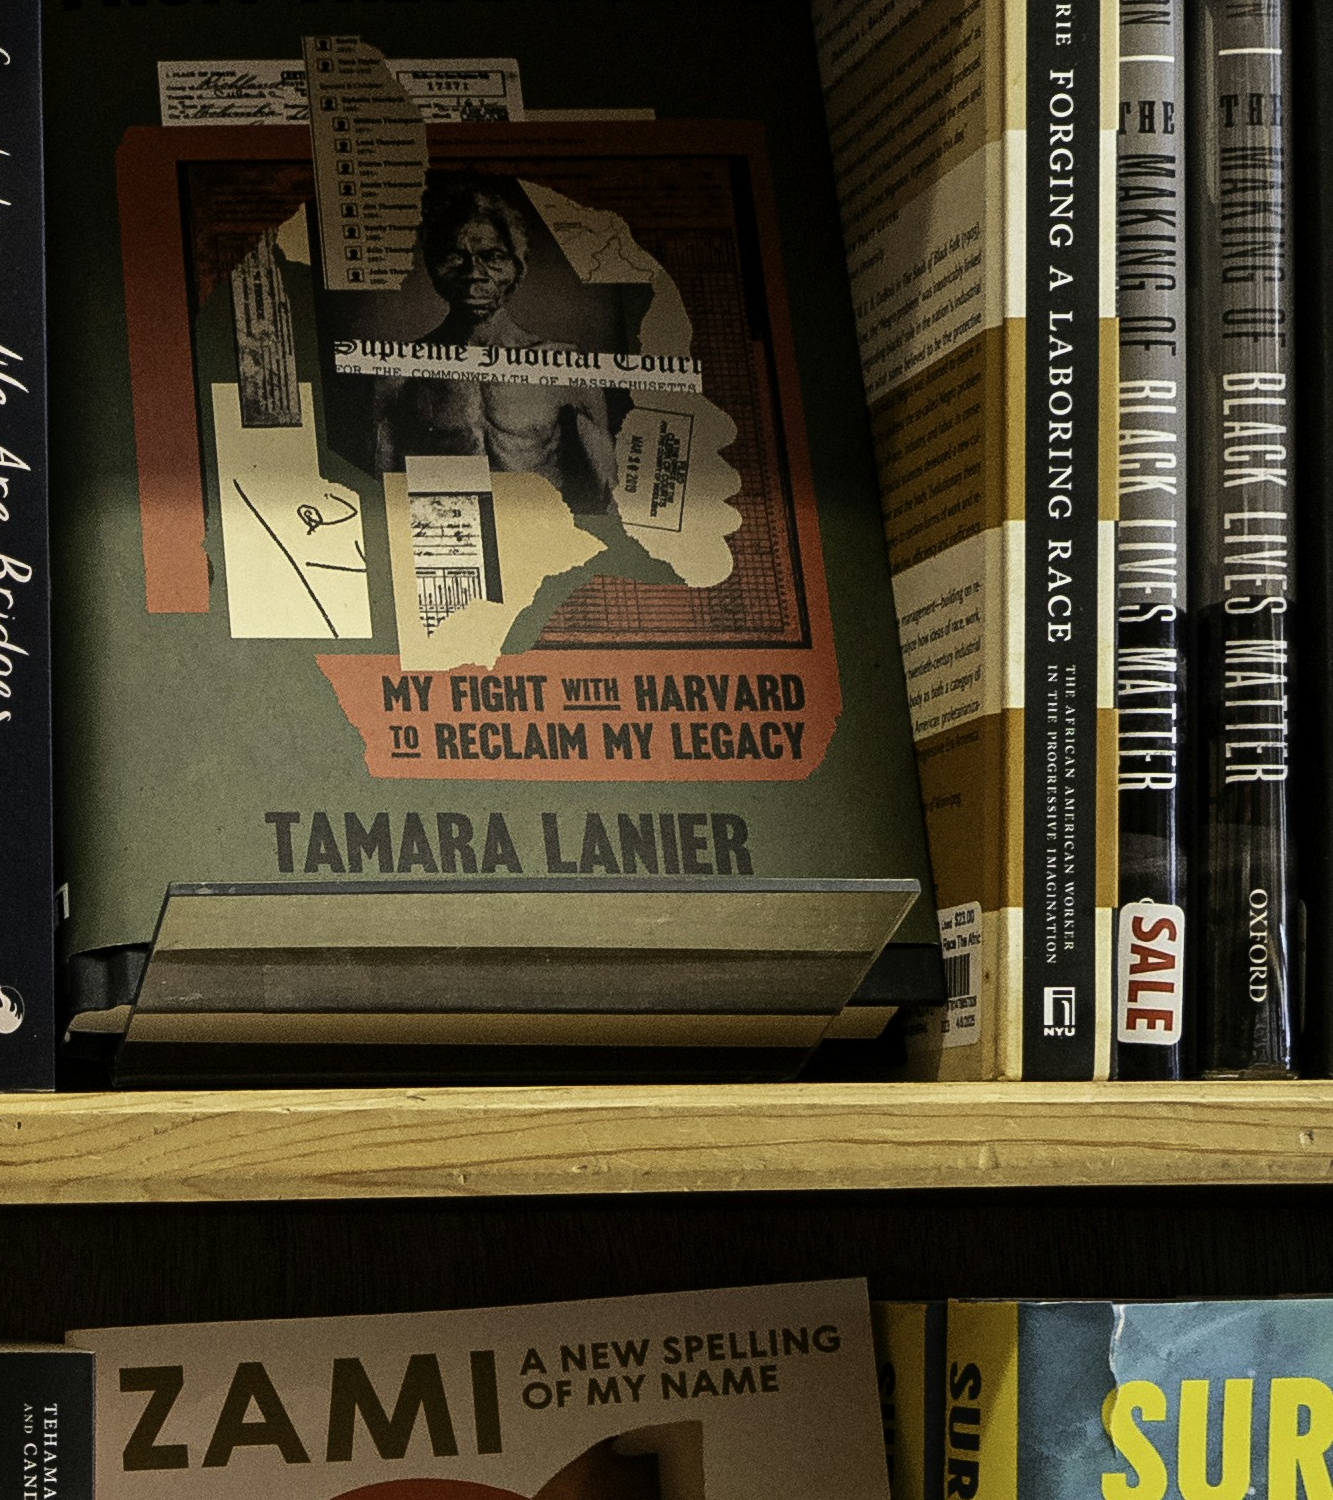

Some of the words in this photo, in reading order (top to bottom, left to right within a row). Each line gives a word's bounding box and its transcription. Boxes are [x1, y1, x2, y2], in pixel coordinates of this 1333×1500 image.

[382, 675, 433, 712] MY
[450, 675, 547, 712] FIGHT
[561, 678, 619, 701] WITH
[635, 673, 806, 712] HARVARD
[265, 812, 523, 873] TAMARA
[542, 812, 754, 876] LANIER
[1126, 916, 1176, 1031] SALE
[1249, 888, 1268, 1003] OXFORD
[119, 1350, 502, 1470] ZAMI
